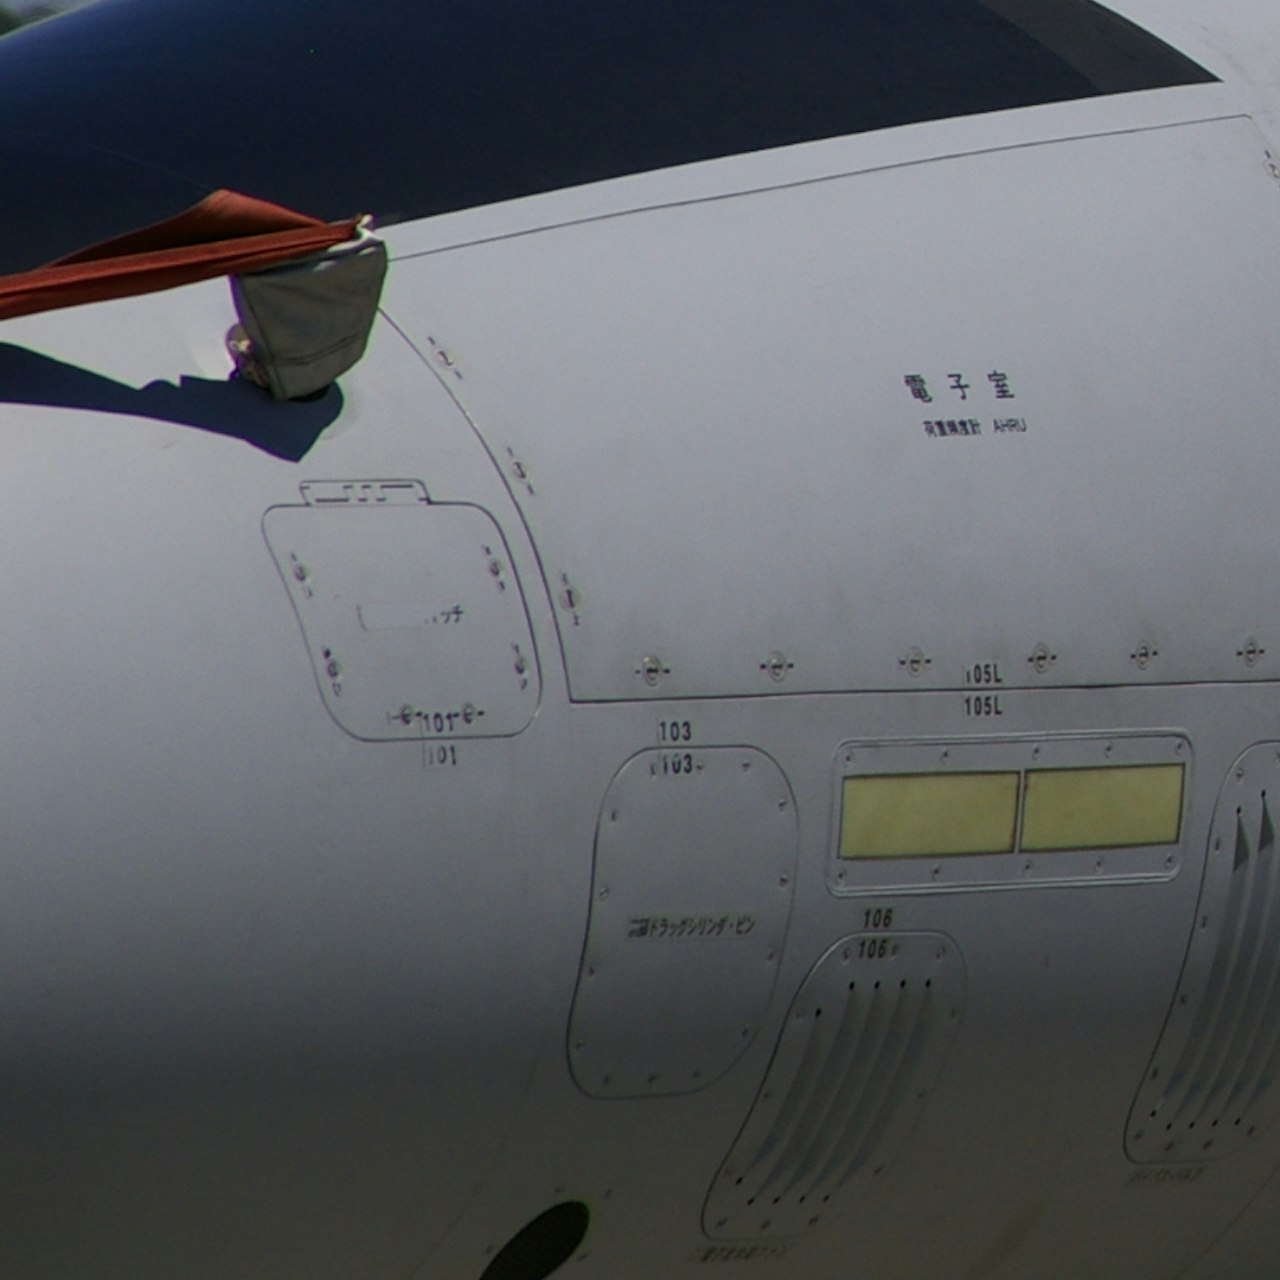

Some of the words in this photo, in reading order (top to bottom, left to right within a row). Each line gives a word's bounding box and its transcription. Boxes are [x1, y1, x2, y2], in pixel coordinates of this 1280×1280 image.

[964, 695, 1003, 716] 105L
[659, 721, 693, 742] 103
[661, 753, 693, 775] 103
[863, 908, 894, 929] 106
[857, 939, 887, 959] 106
